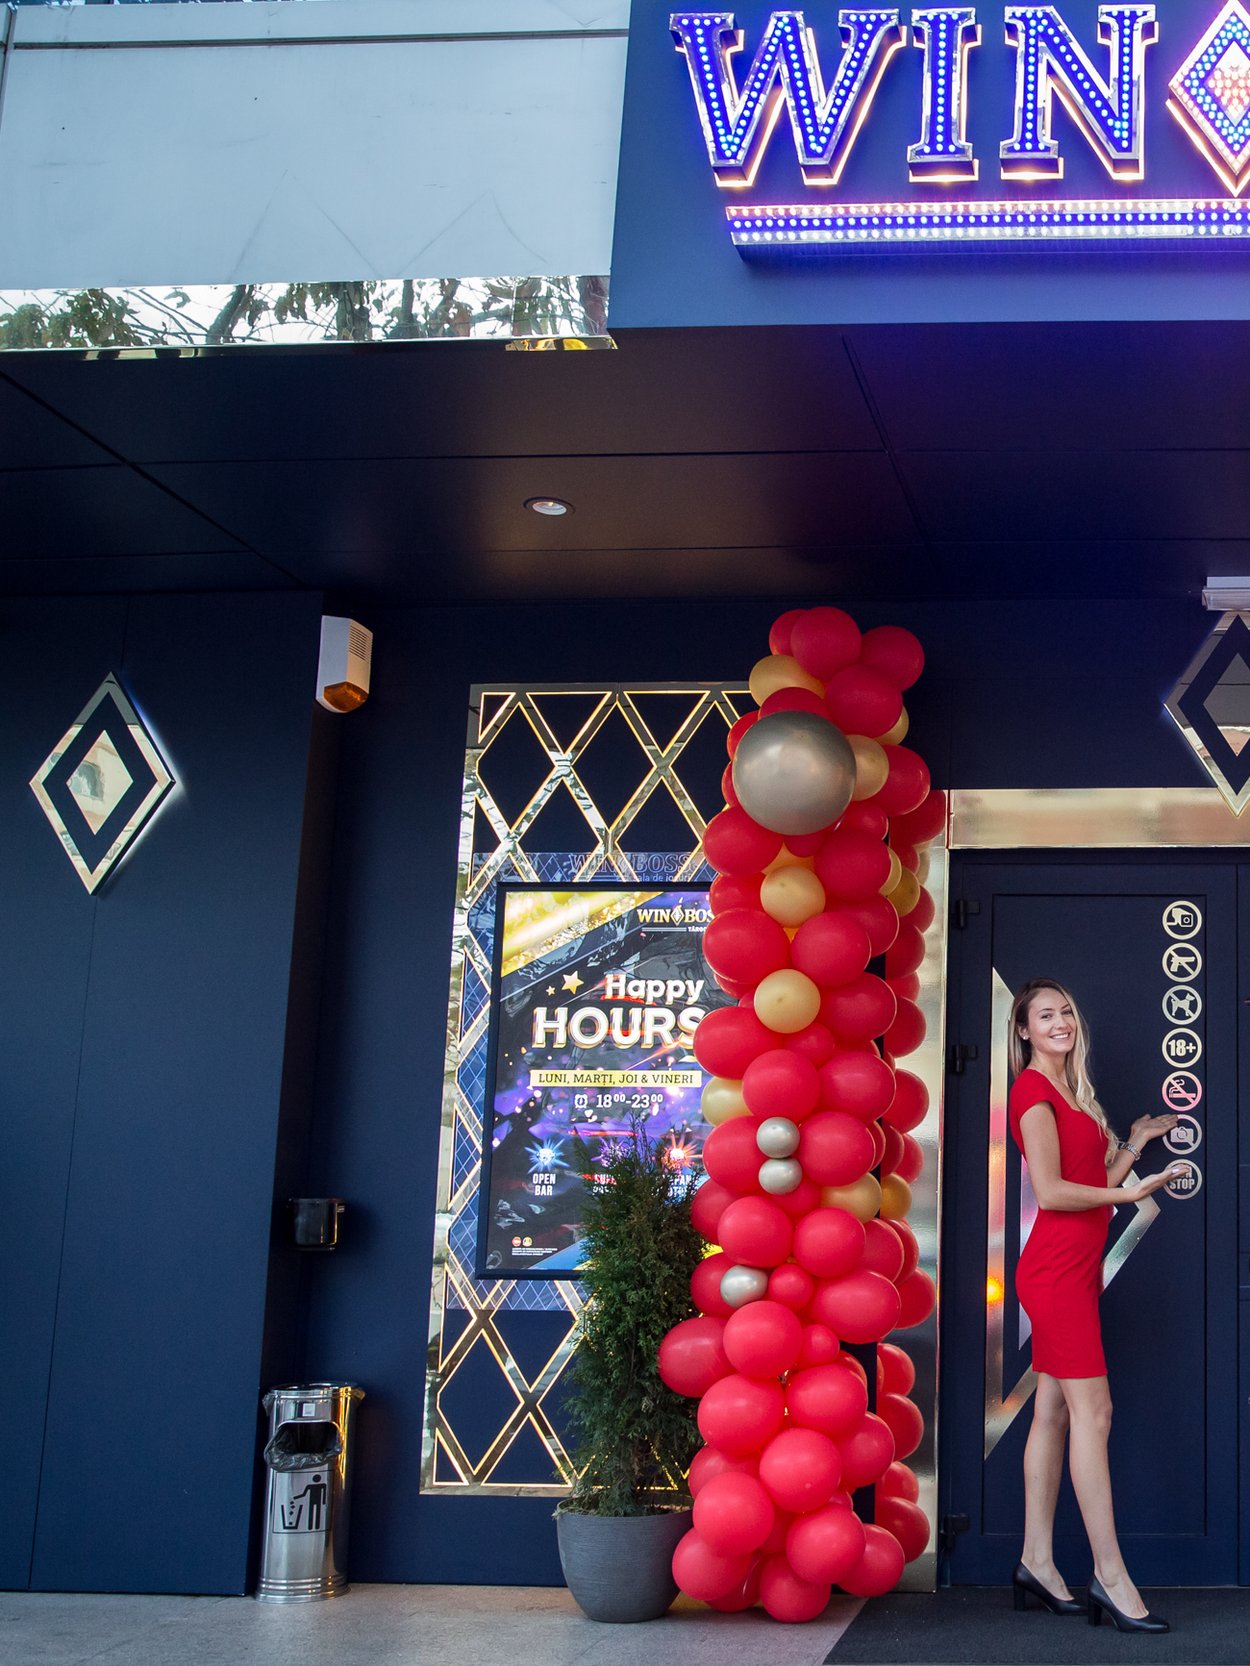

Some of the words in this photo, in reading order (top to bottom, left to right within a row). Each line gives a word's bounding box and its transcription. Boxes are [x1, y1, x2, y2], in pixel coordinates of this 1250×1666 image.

[669, 3, 1158, 187] WIN
[652, 873, 664, 882] de
[637, 908, 671, 923] WIN
[604, 973, 705, 1006] Happy
[1168, 1039, 1197, 1057] 18+
[538, 1073, 571, 1085] LUNI,
[618, 1074, 638, 1084] JOI
[641, 1074, 649, 1084] &
[651, 1074, 694, 1084] VINERI
[532, 1173, 557, 1185] OPEN
[1169, 1178, 1195, 1190] STOP
[534, 1185, 553, 1196] BAR
